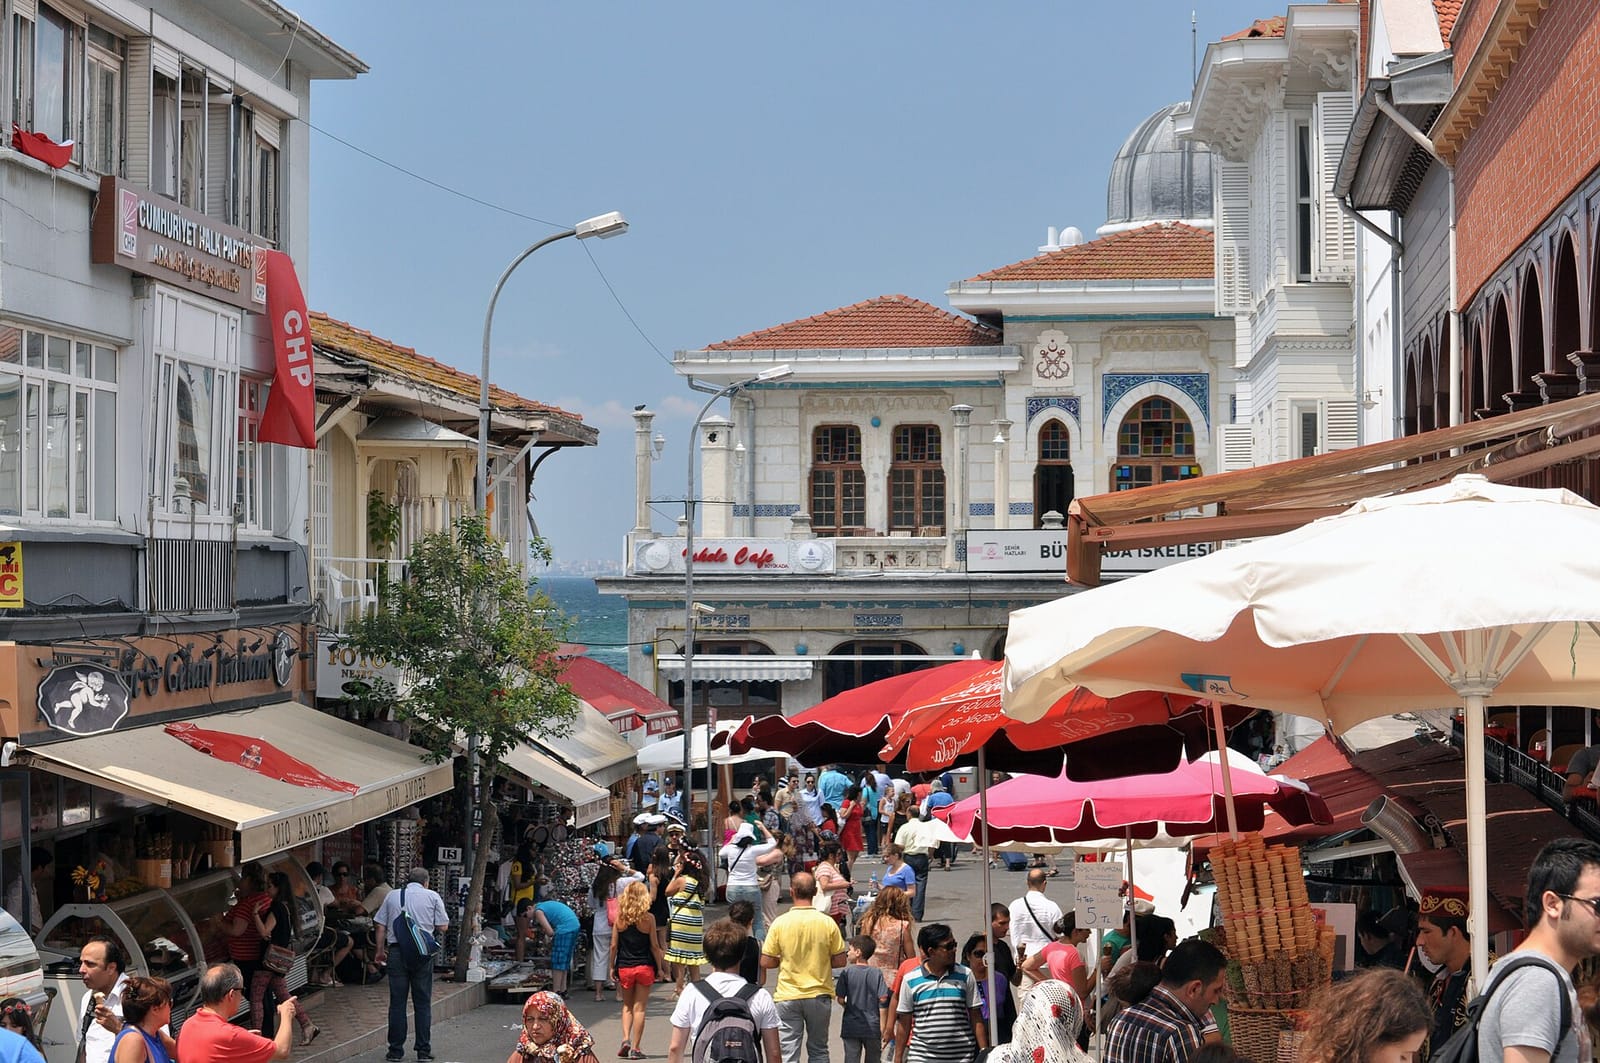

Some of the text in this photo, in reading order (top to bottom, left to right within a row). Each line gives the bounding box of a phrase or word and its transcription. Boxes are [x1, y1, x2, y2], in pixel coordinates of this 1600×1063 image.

[138, 200, 198, 247] CUMHURİYET
[199, 225, 221, 258] HALK
[283, 309, 312, 387] CHP
[733, 545, 774, 569] Cafe
[385, 776, 427, 811] MIO AMORE
[273, 811, 330, 849] MIO AMORE
[1085, 906, 1097, 925] 5
